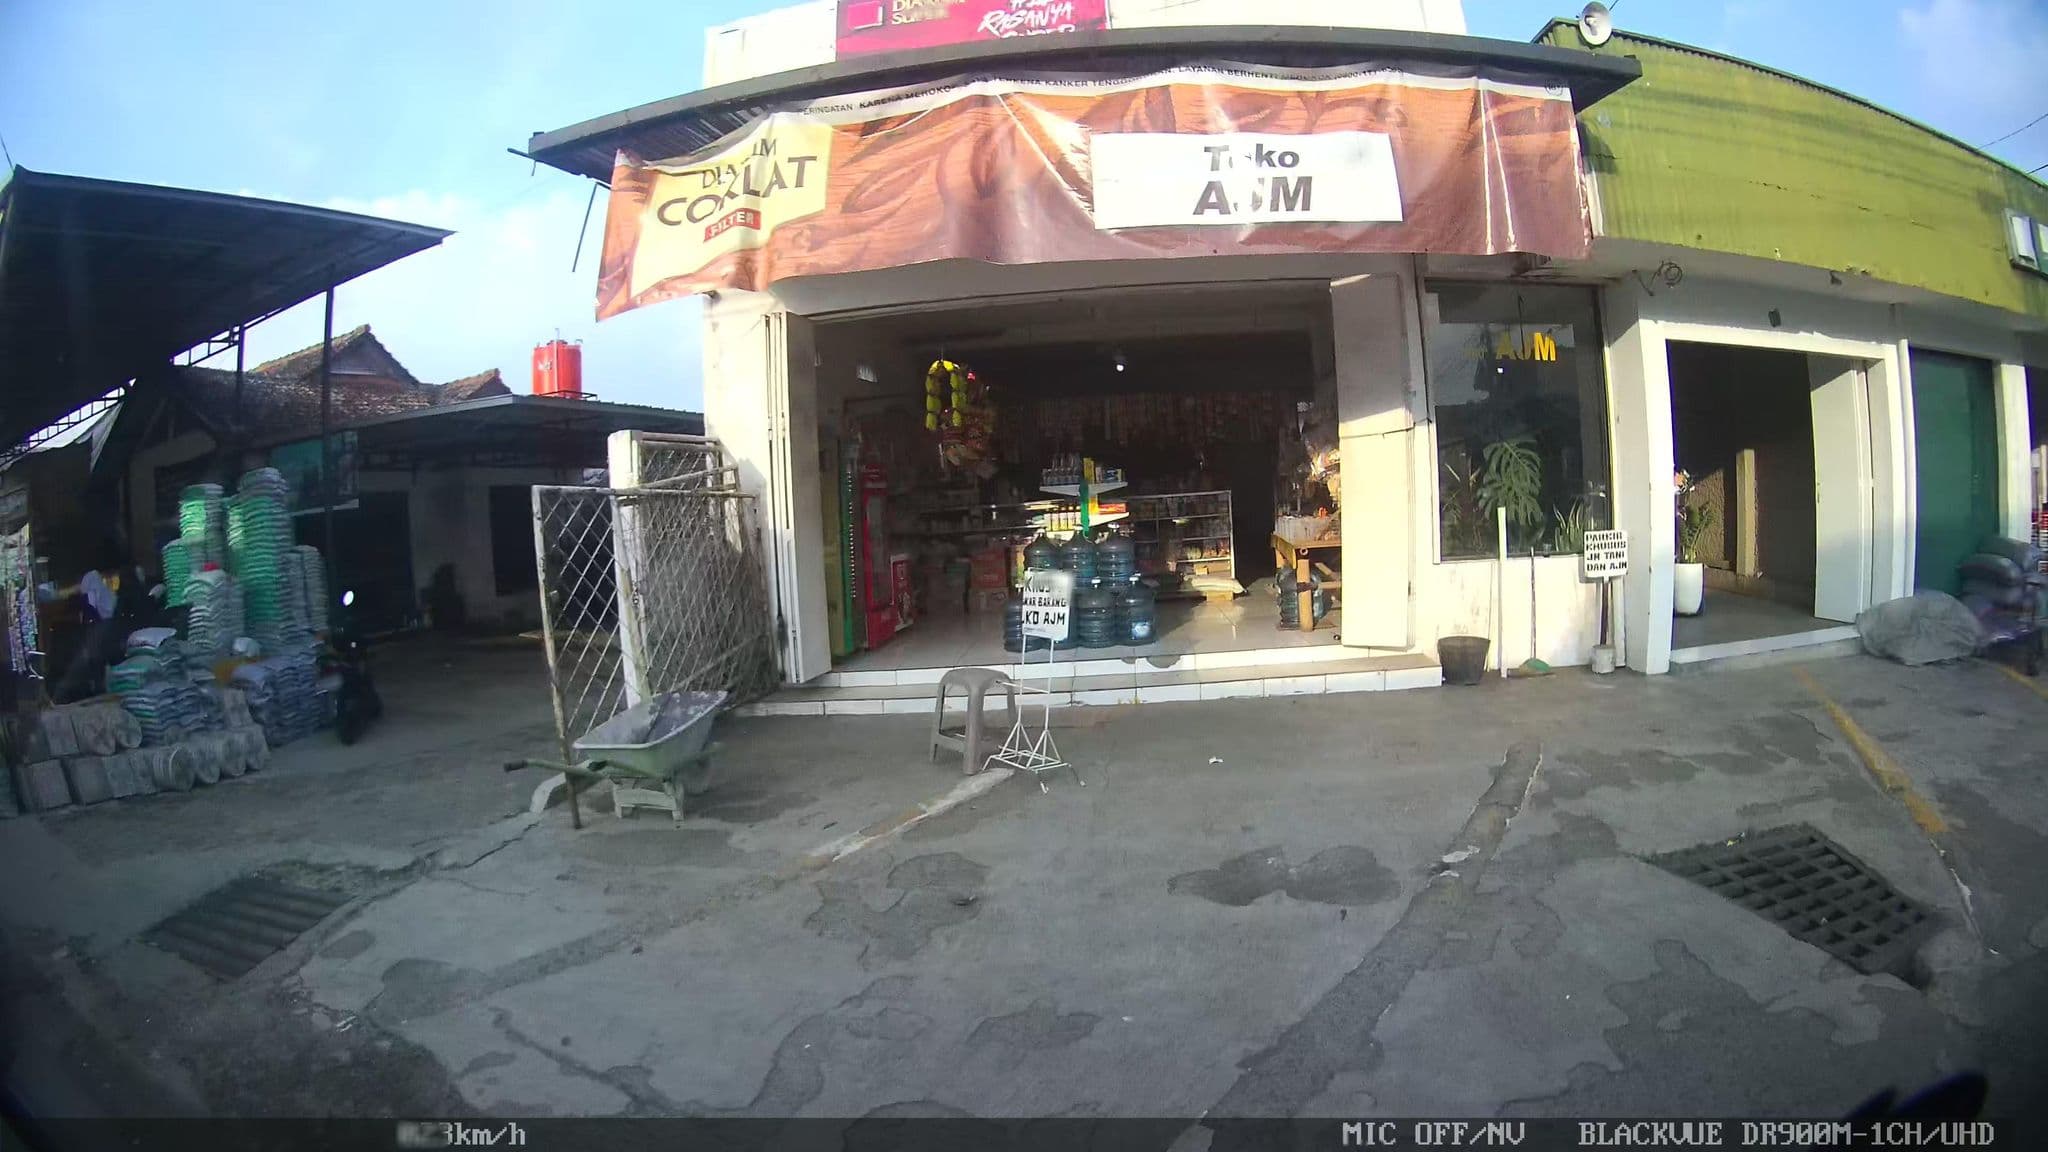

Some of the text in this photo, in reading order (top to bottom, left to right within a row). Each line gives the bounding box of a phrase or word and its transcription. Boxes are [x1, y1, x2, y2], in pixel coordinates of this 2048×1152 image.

[801, 103, 853, 115] ERINGATAN
[1045, 79, 1088, 87] KANKER
[1204, 143, 1300, 171] Tko
[1496, 331, 1556, 361] AJM
[1043, 612, 1066, 626] AJM
